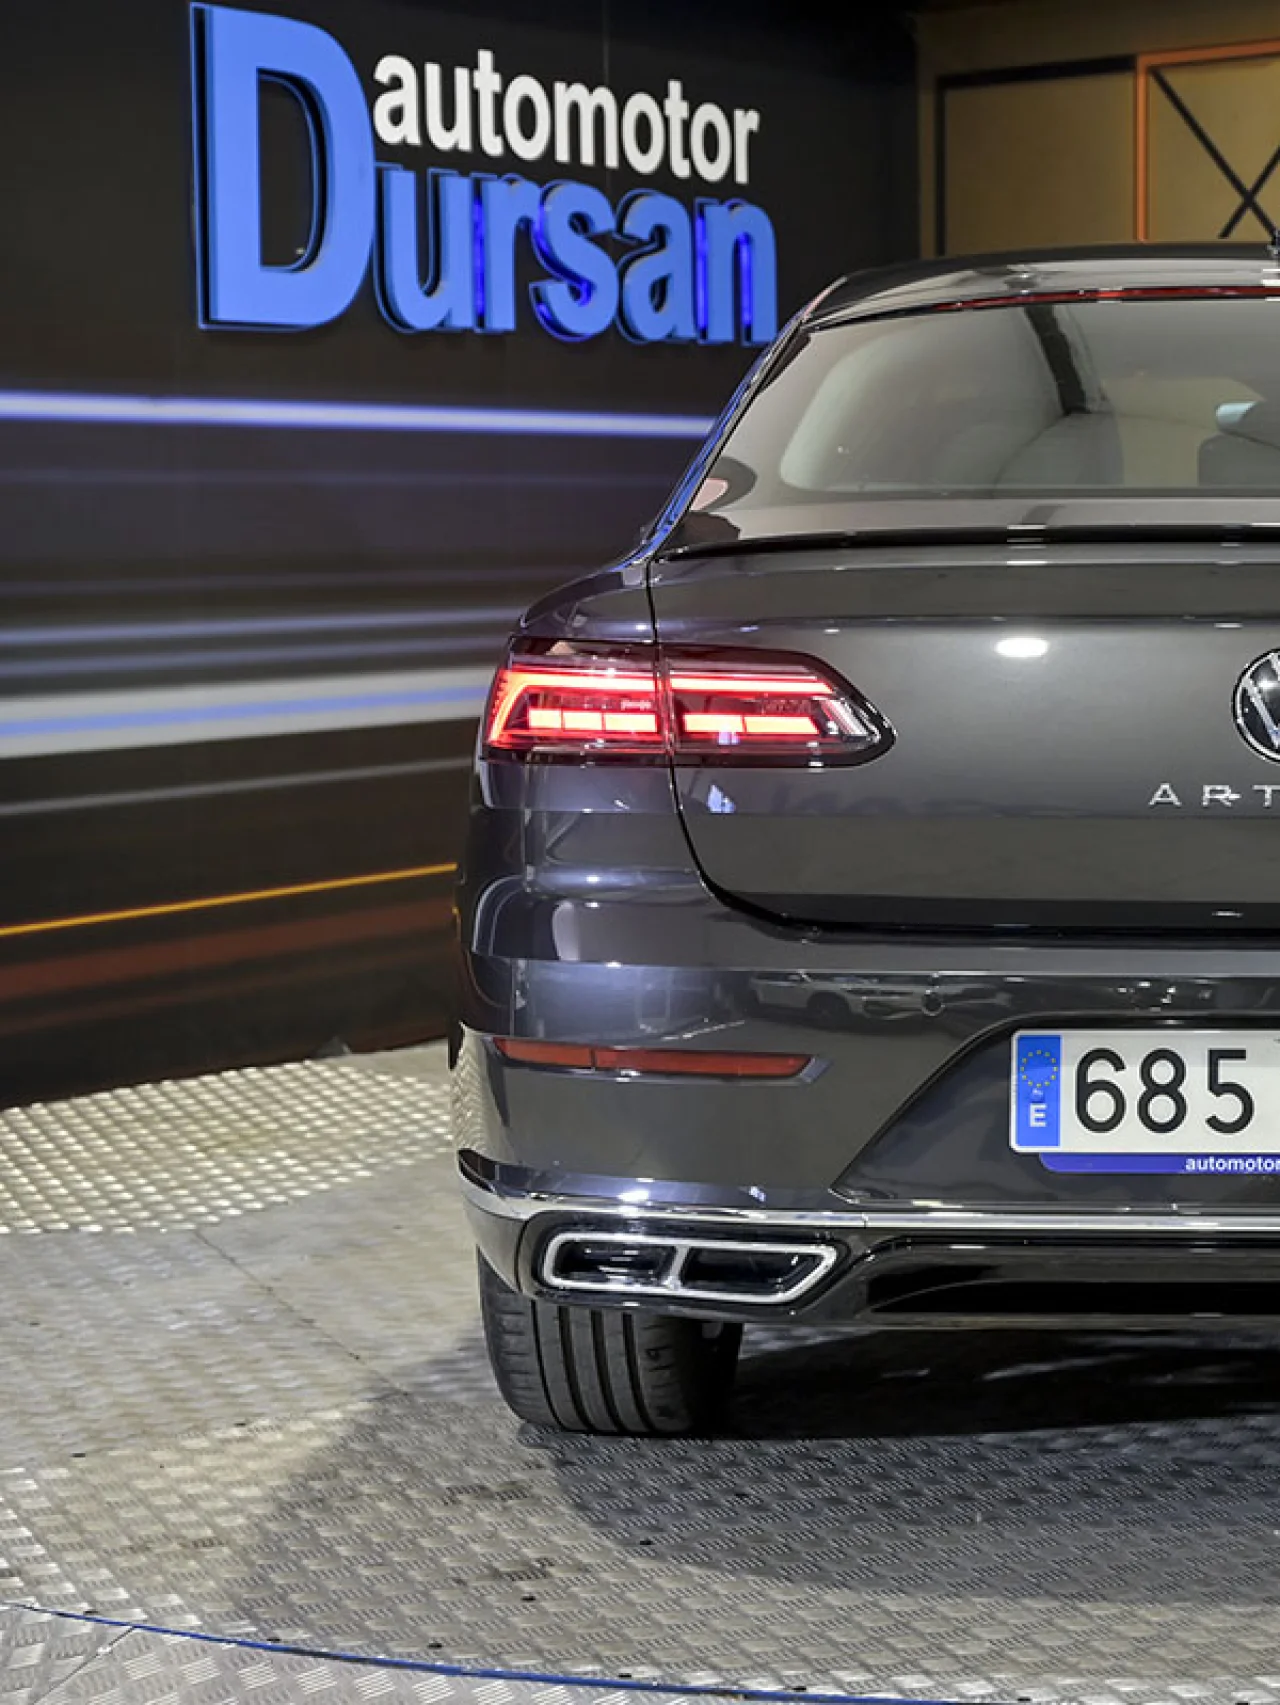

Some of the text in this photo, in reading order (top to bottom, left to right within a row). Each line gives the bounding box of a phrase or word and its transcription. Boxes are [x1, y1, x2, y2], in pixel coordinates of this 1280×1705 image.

[191, 2, 778, 347] Dursan
[373, 48, 760, 184] automotor
[1029, 1103, 1047, 1128] E
